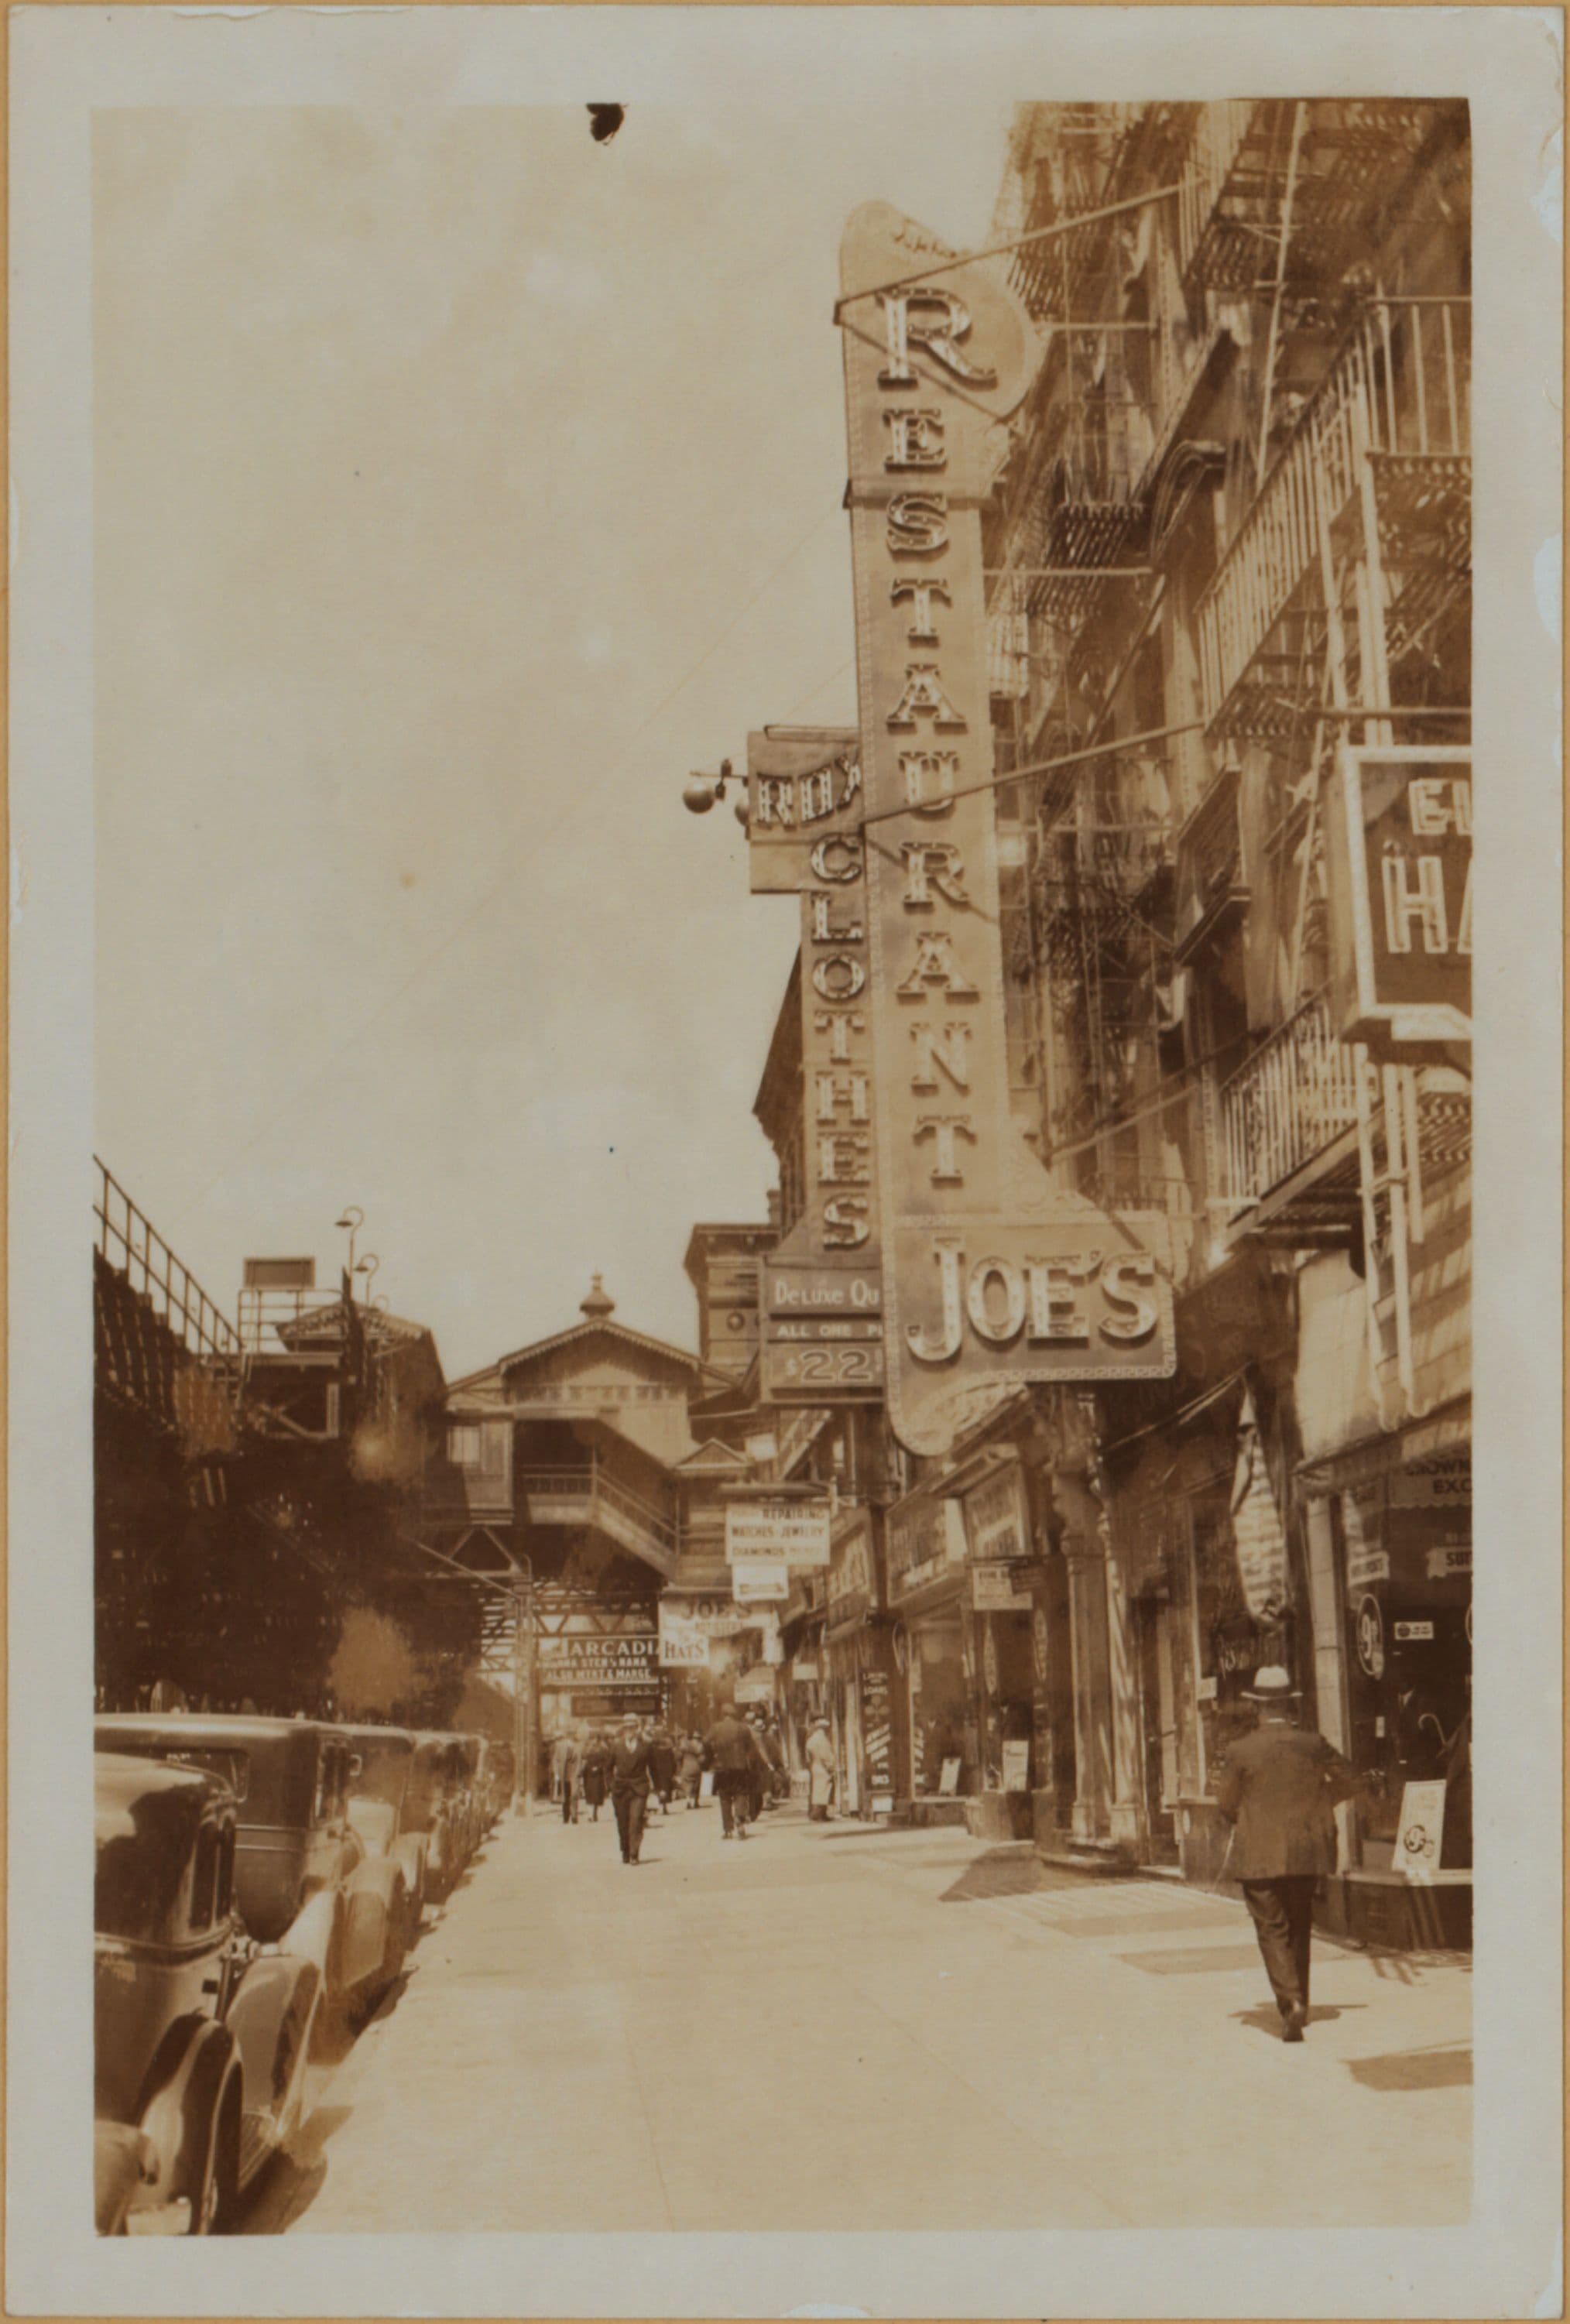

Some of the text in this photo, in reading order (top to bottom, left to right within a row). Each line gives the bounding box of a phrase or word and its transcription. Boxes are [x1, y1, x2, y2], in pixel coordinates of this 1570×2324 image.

[875, 286, 999, 1181] RESTAURANT
[1381, 855, 1472, 955] H
[811, 831, 871, 1251] CLOTHES
[776, 1325, 810, 1339] ALL
[819, 1323, 852, 1338] ONE
[905, 1236, 1160, 1369] JOE'S
[569, 1640, 659, 1656] ARCADI
[663, 1638, 704, 1660] HATS
